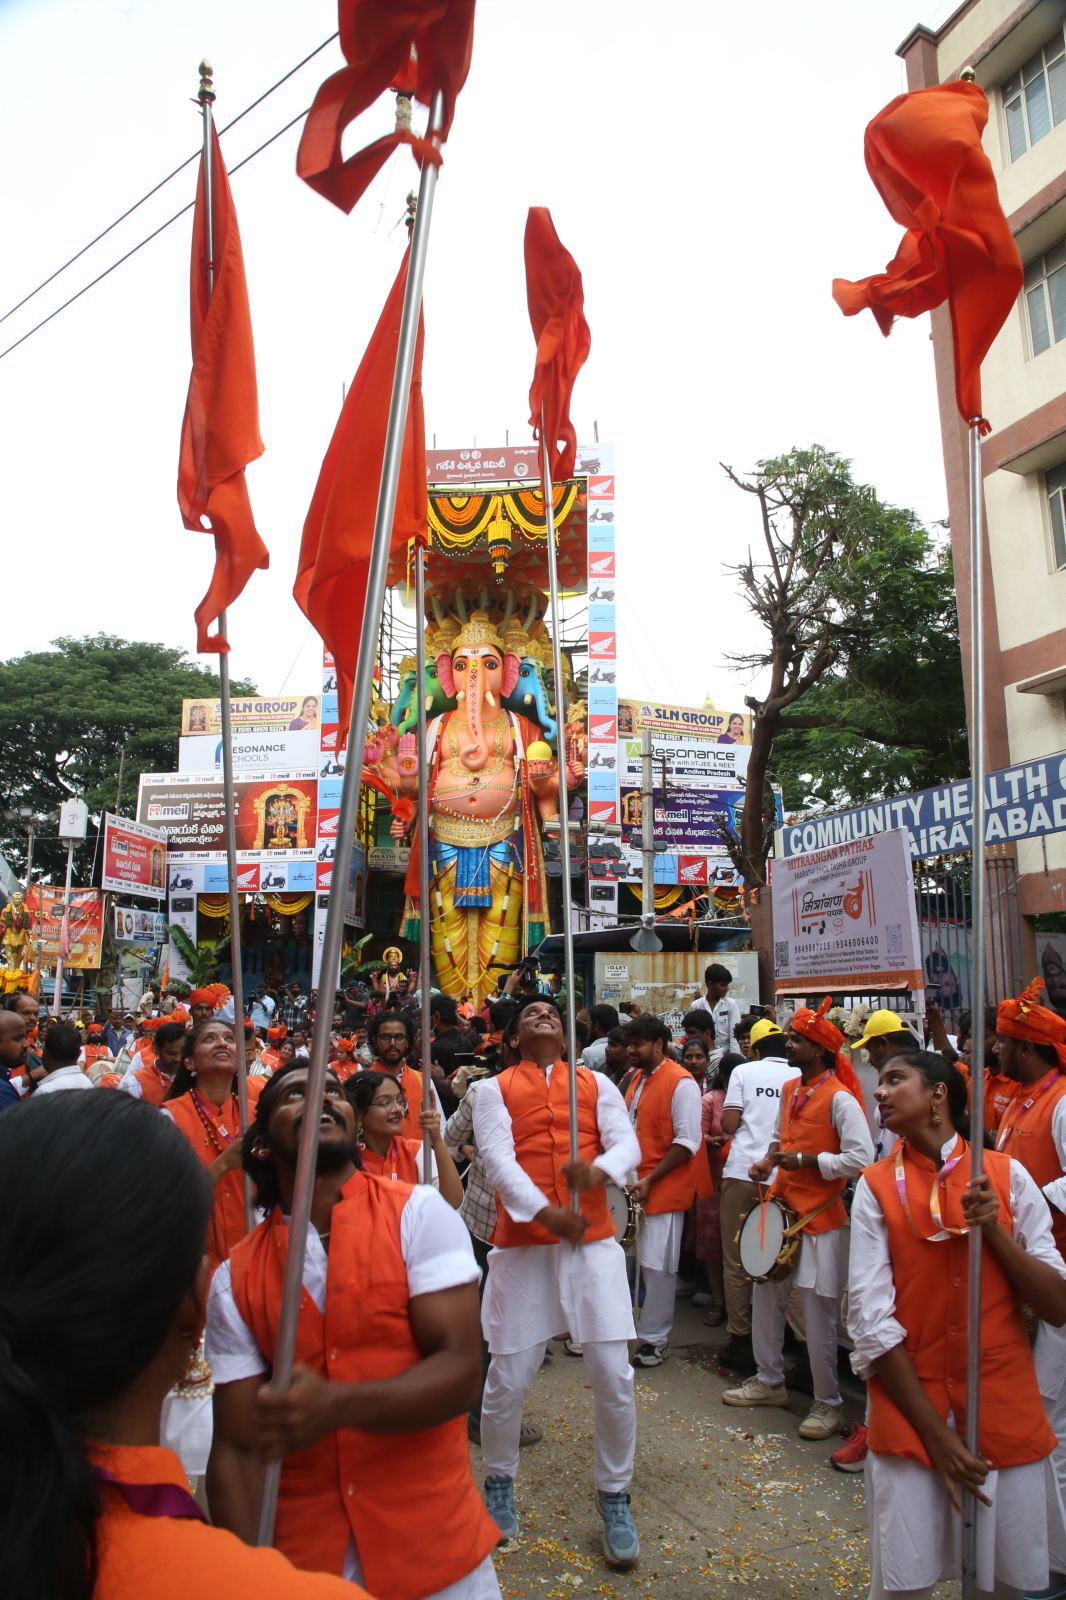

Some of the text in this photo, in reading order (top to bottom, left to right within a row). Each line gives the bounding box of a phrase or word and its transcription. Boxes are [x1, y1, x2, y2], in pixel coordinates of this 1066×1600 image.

[254, 701, 297, 713] GROUP
[655, 708, 724, 726] SLN GROUP
[232, 744, 286, 754] ESONANCE
[232, 754, 269, 762] CHOOLS
[163, 804, 188, 816] meil
[667, 809, 688, 818] meil
[790, 796, 924, 855] COMMUNITY
[932, 763, 1048, 822] HELTH
[908, 797, 1066, 856] AIRAABAD
[787, 838, 874, 871] MITRAANGAN PATHAK
[847, 855, 867, 867] GROUP
[826, 909, 844, 917] पथक
[756, 1088, 780, 1098] POL
